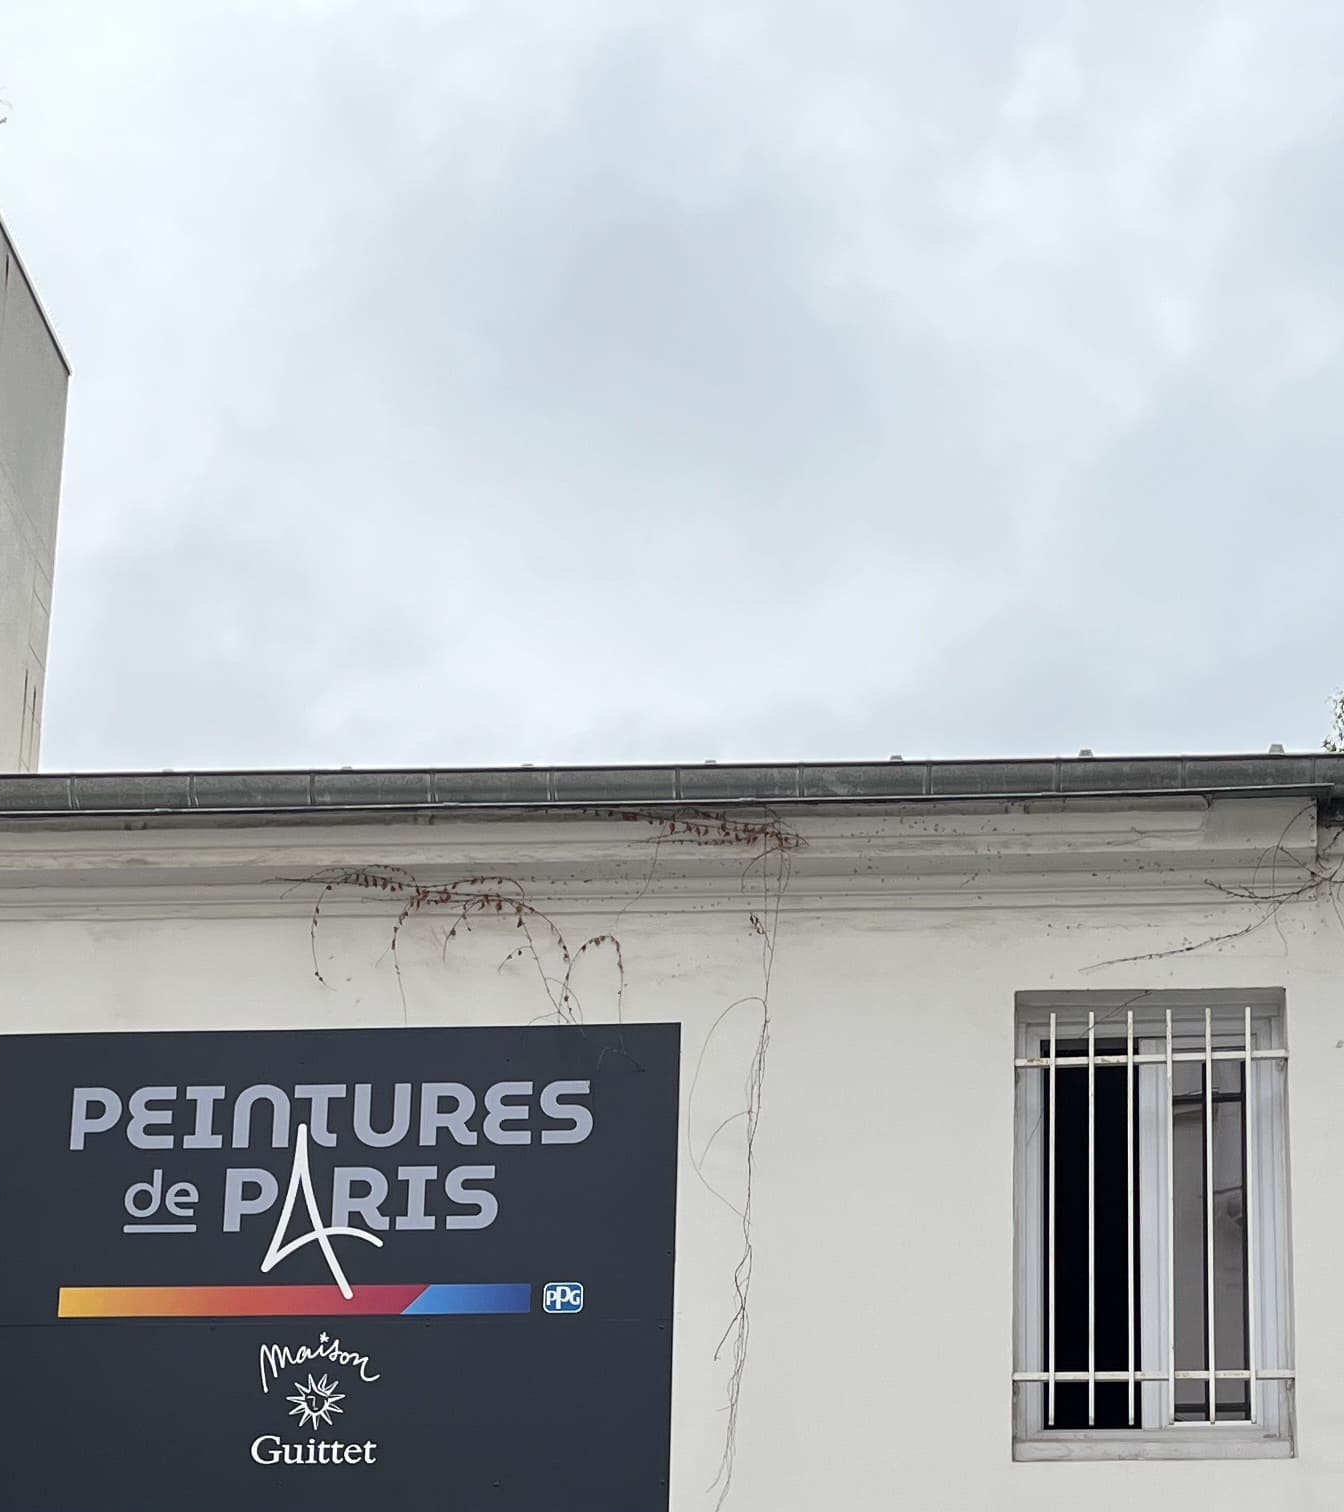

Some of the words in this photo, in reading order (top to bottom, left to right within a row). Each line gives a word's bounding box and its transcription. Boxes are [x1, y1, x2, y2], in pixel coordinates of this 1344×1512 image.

[69, 1080, 594, 1150] PEINTURES
[123, 1169, 199, 1217] de
[546, 1286, 581, 1310] PPG
[250, 1435, 377, 1465] Guittet
